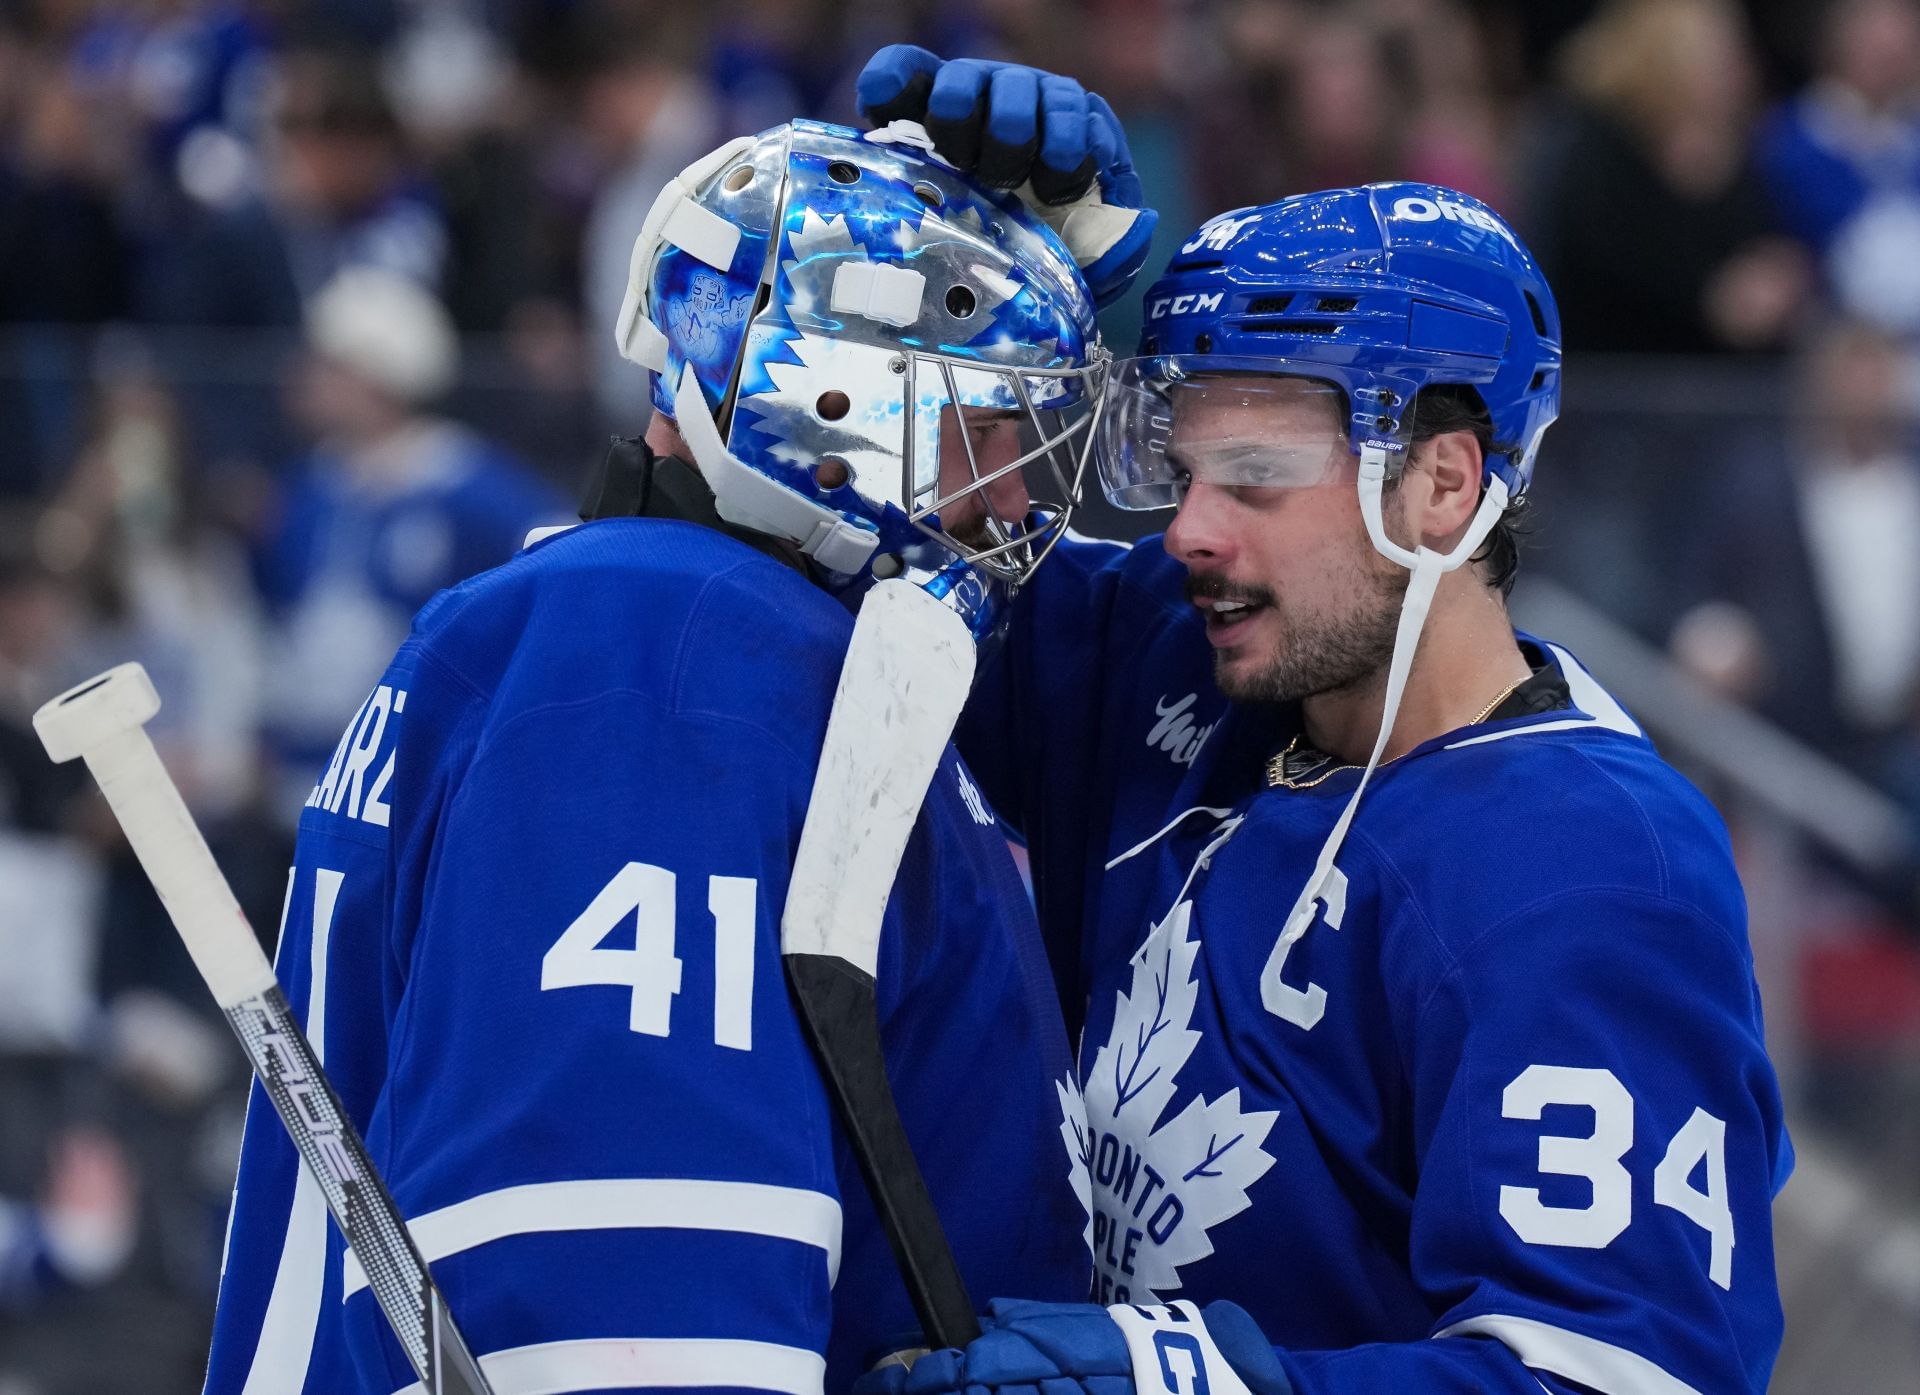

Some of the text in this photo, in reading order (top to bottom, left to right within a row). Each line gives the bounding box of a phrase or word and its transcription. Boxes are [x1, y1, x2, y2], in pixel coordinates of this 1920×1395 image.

[1151, 292, 1225, 319] CCM
[1145, 692, 1222, 770] Mil
[540, 860, 758, 1052] 41
[1260, 863, 1348, 1031] C
[1499, 1064, 1736, 1292] 34
[1093, 1209, 1144, 1277] PLE
